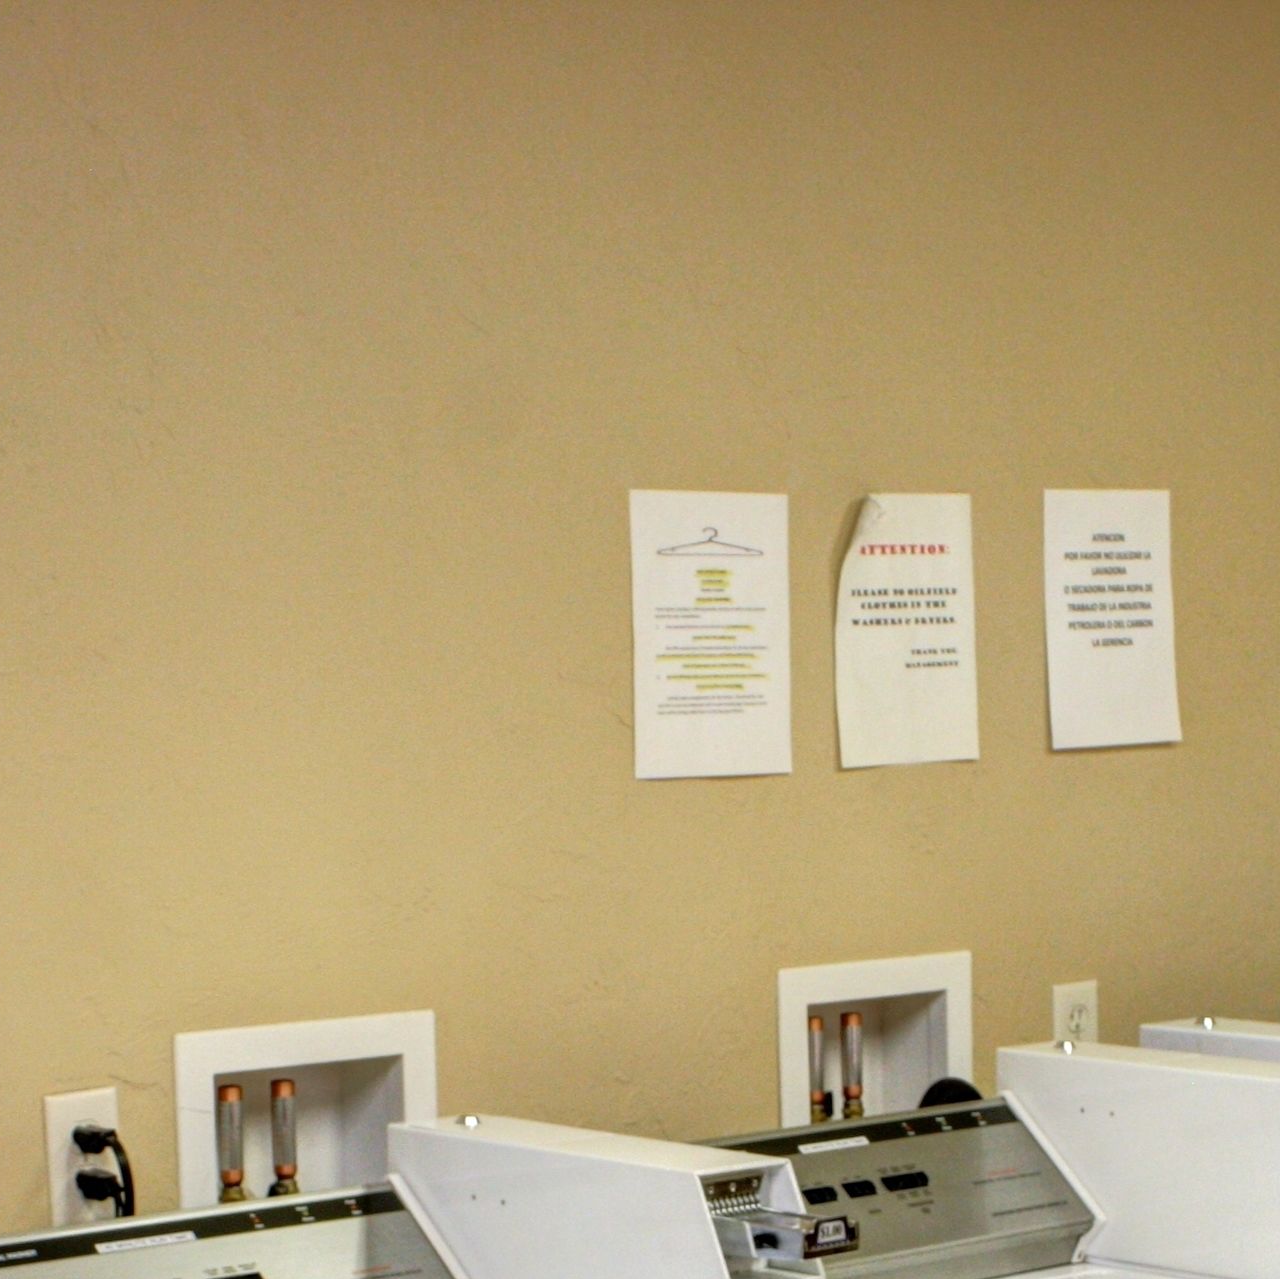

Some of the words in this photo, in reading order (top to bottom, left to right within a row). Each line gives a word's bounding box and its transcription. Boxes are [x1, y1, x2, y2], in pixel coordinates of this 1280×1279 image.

[860, 544, 950, 556] ATTENTION:
[851, 588, 889, 597] PLEASE
[907, 587, 957, 596] OILFIELD
[861, 601, 908, 610] CLOTHES
[926, 600, 946, 608] THE
[852, 618, 902, 626] WASHERS
